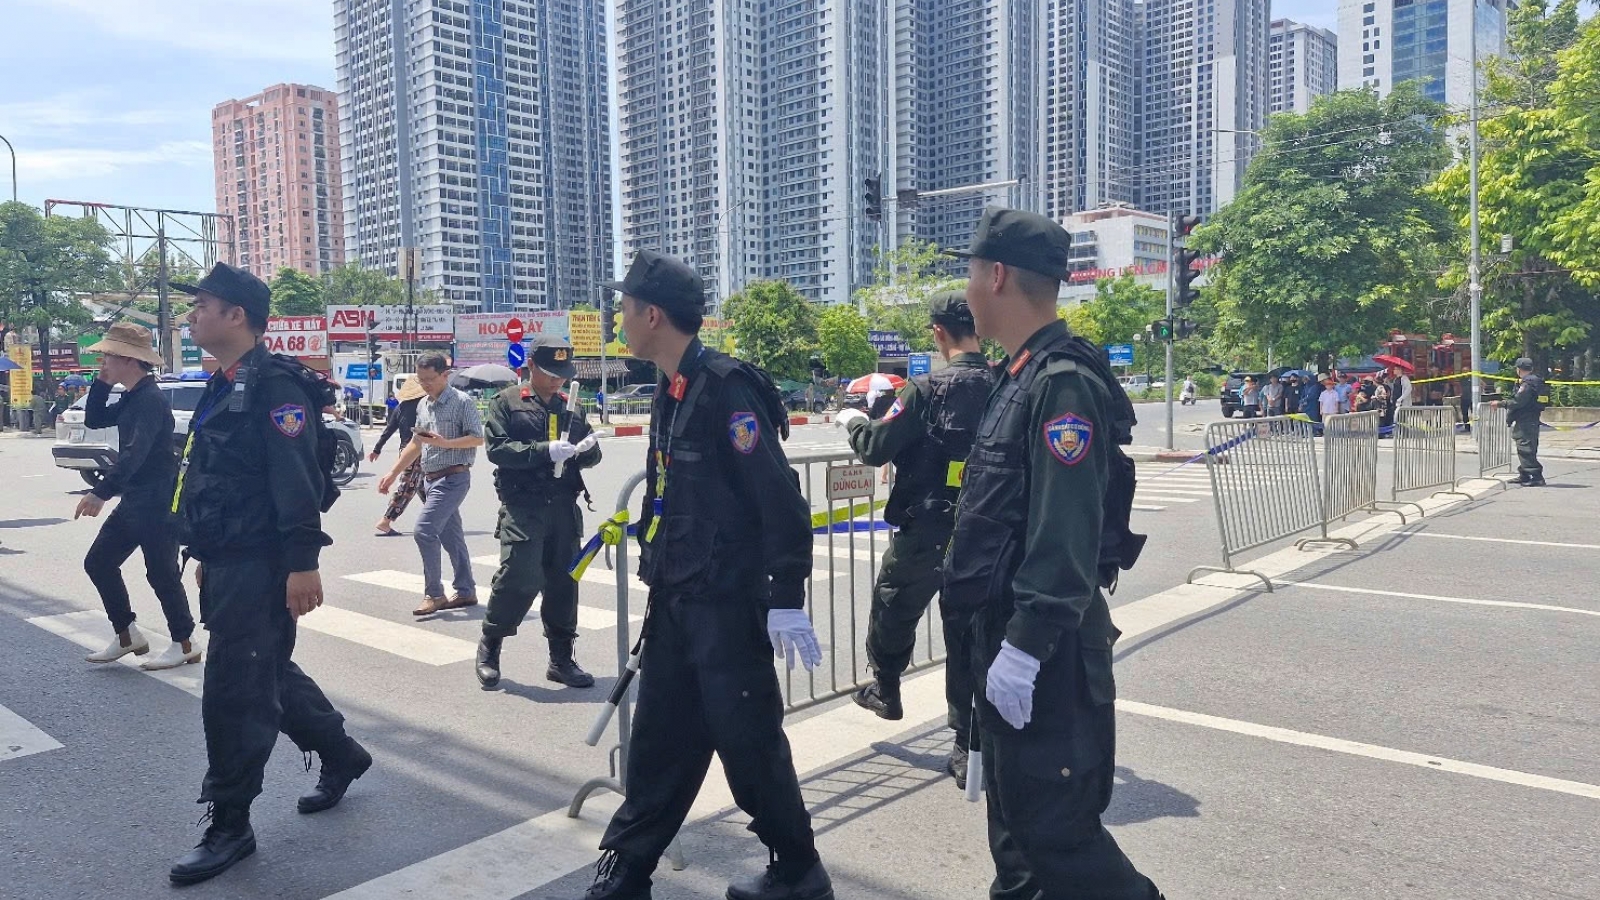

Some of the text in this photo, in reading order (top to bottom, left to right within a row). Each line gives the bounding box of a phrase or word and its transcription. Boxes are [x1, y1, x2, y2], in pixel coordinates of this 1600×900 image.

[290, 320, 302, 330] XE
[331, 310, 375, 328] ABM
[478, 321, 507, 335] HOA
[287, 335, 305, 351] 68
